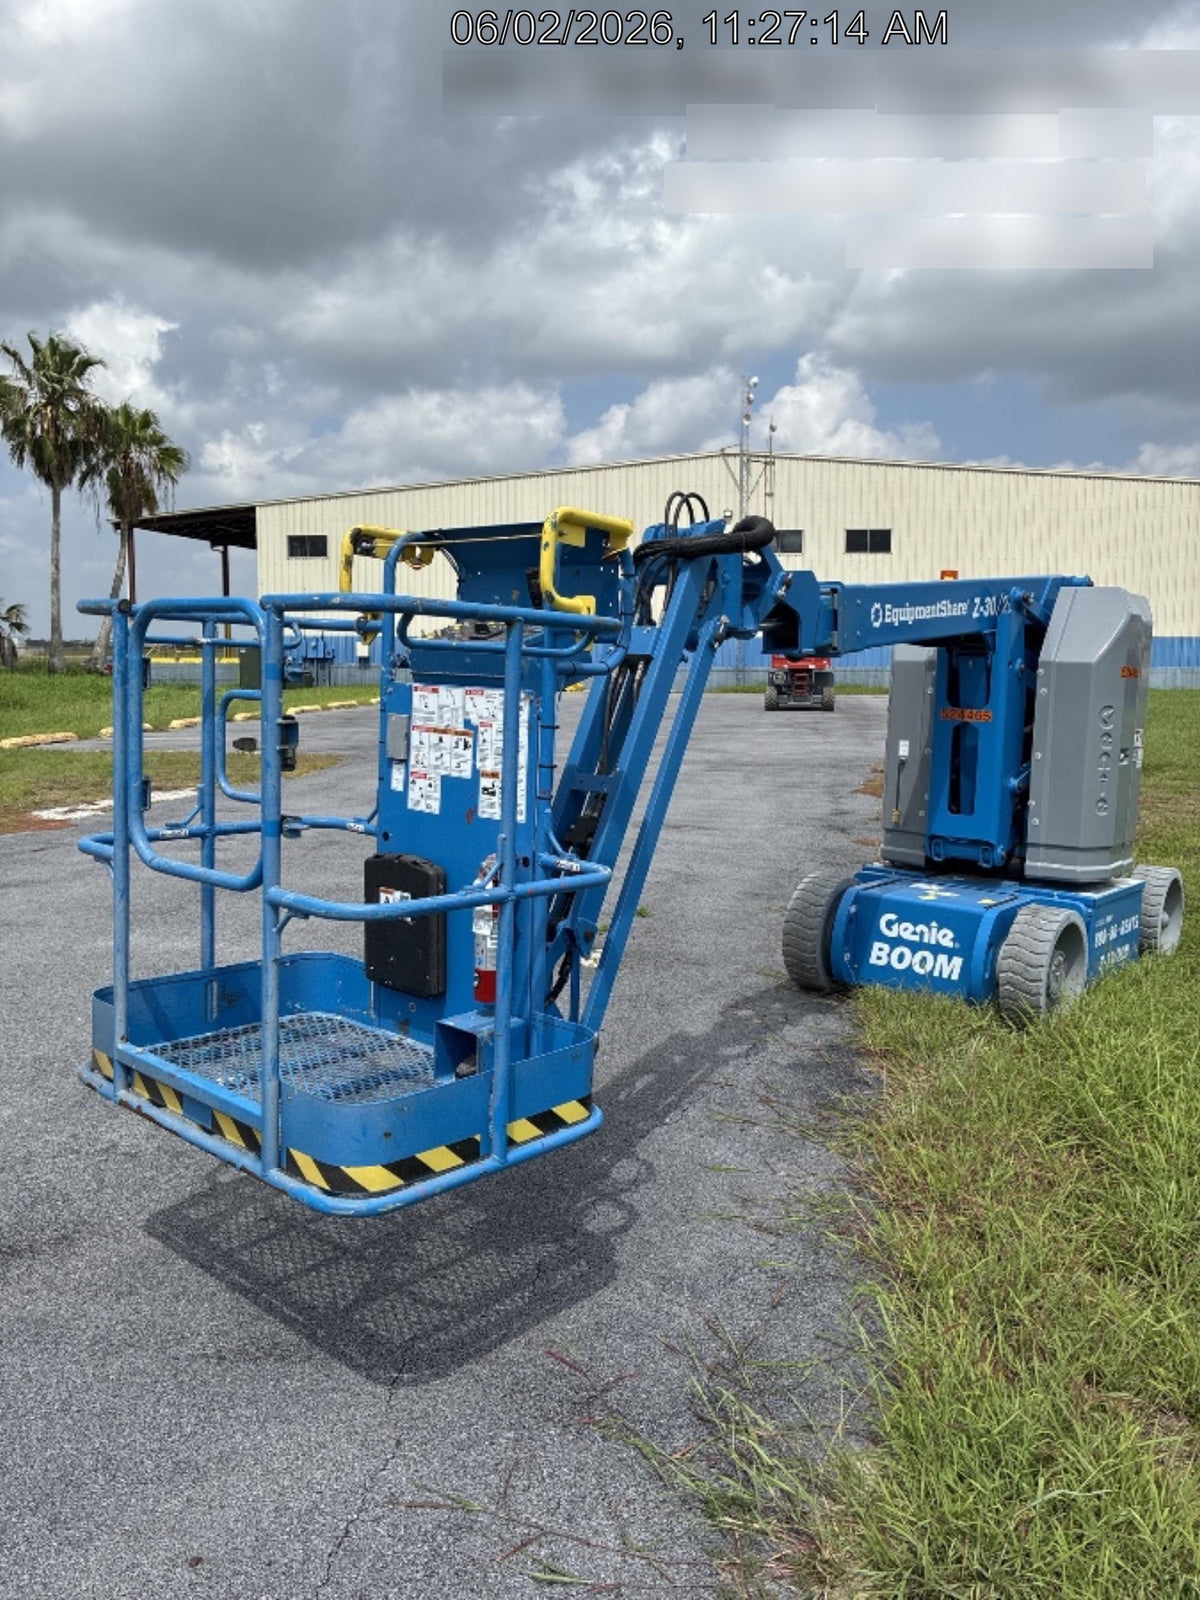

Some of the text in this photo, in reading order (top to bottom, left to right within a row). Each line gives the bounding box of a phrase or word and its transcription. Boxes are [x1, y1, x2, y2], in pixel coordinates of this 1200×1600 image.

[884, 599, 969, 627] EquipmentShare
[879, 912, 956, 948] Genie
[869, 941, 965, 981] BOOM
